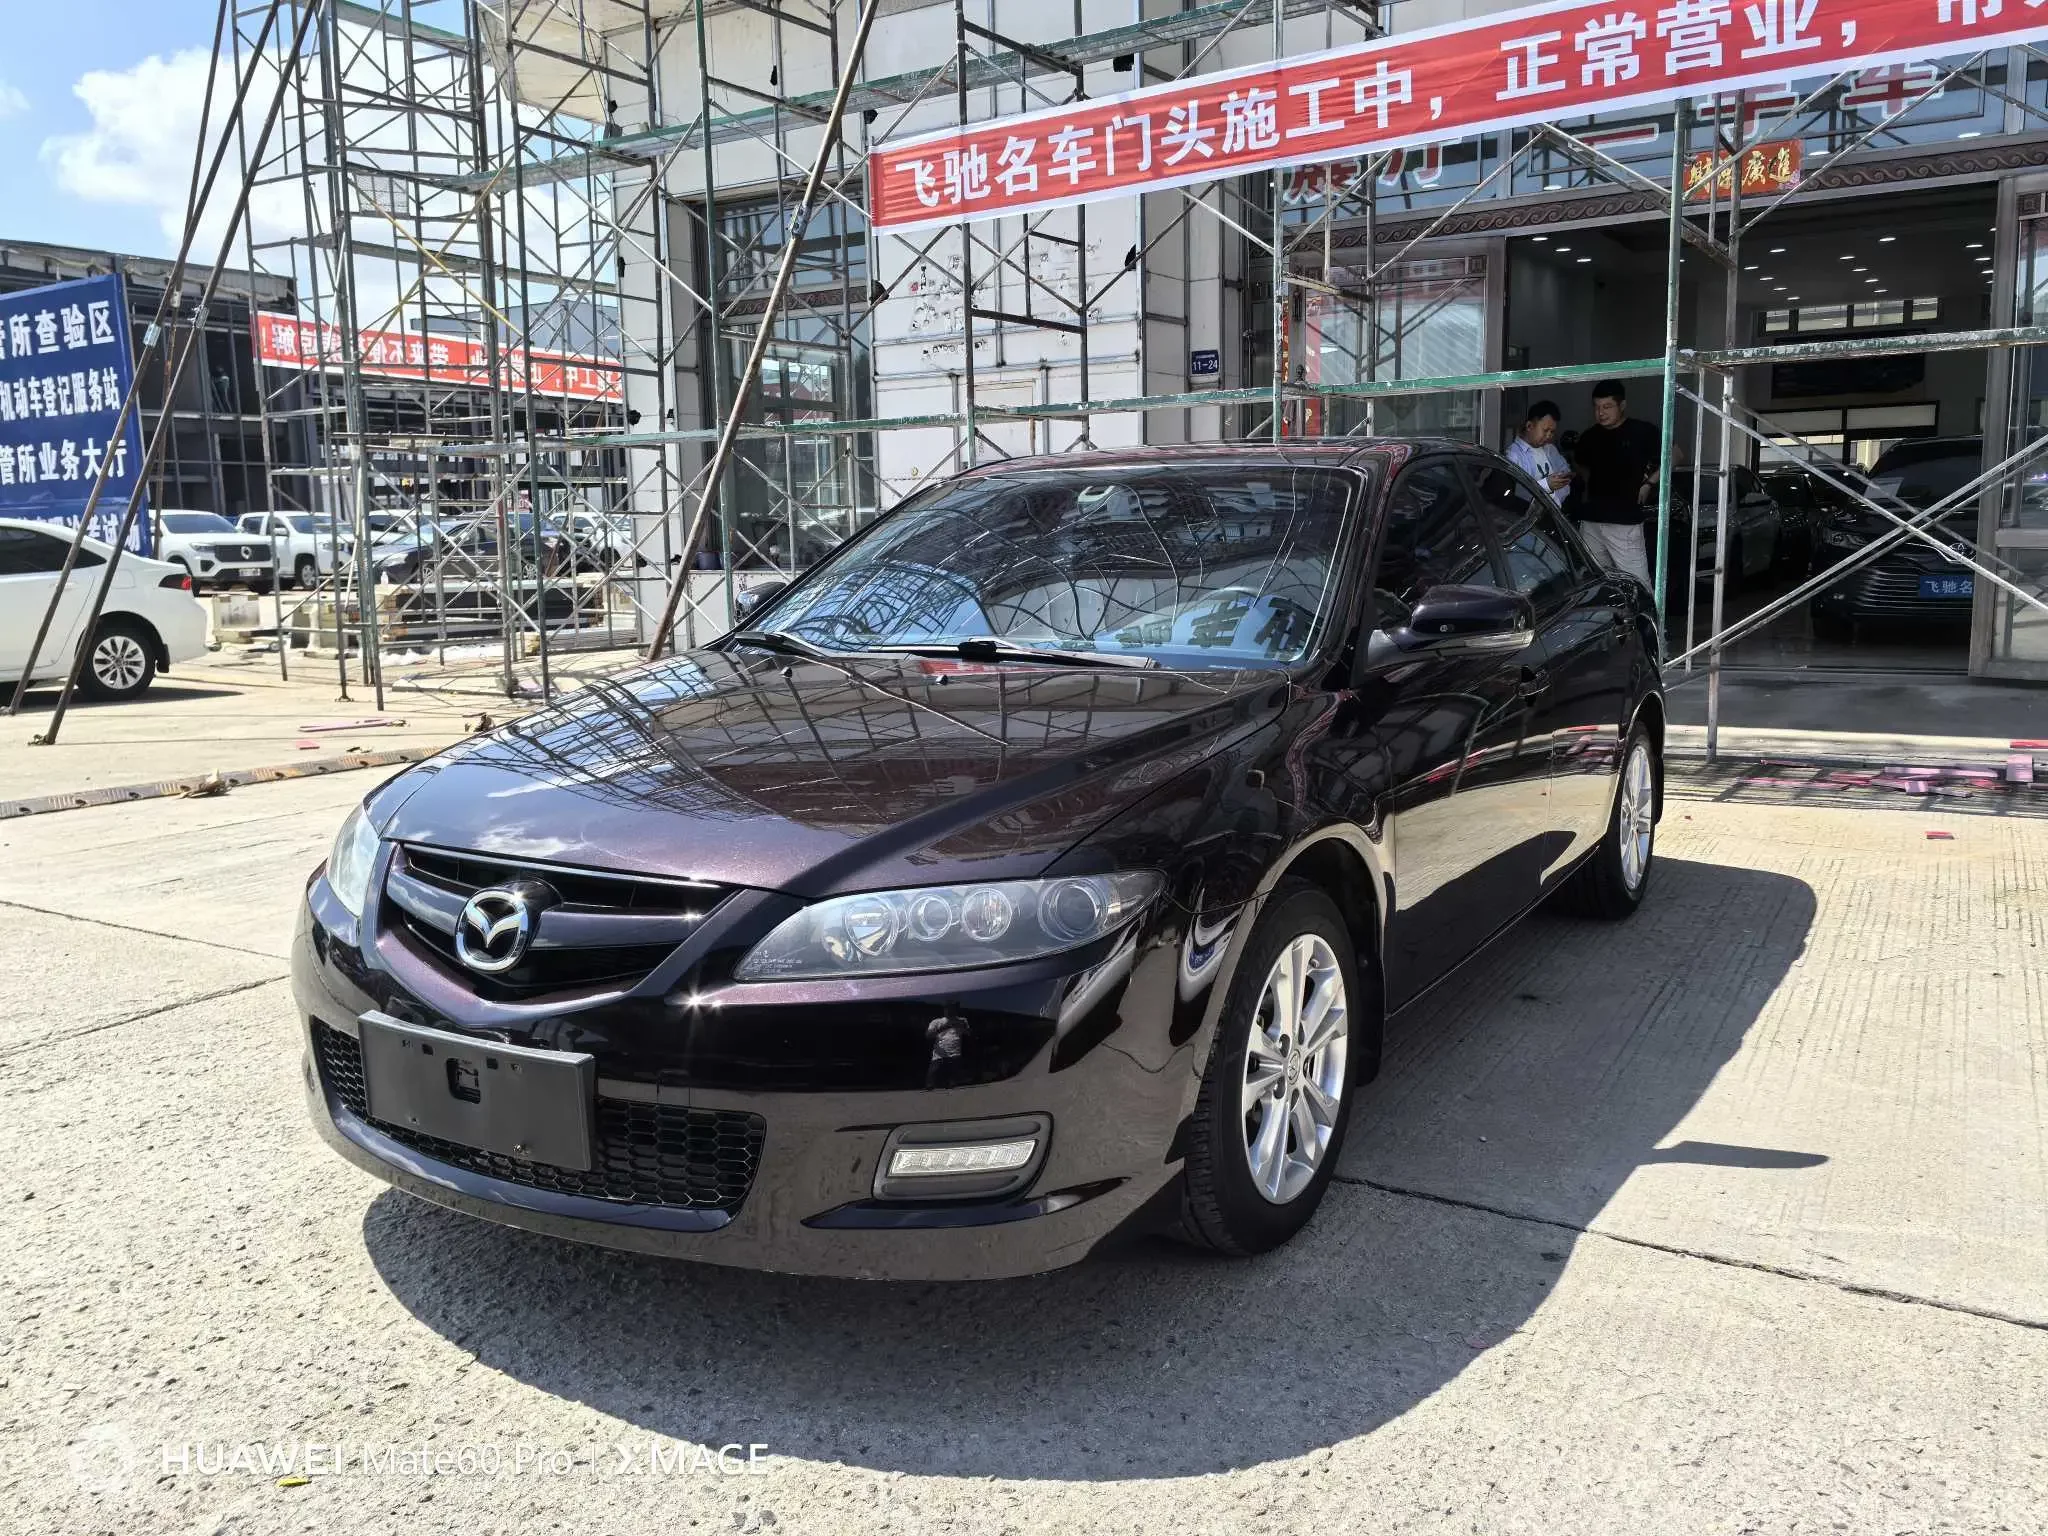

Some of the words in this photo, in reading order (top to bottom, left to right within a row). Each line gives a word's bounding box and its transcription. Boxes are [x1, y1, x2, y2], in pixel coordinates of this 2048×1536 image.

[895, 0, 2048, 208] 飞驰名车门头施工中，正常营业，
[0, 300, 115, 359] 所查验区
